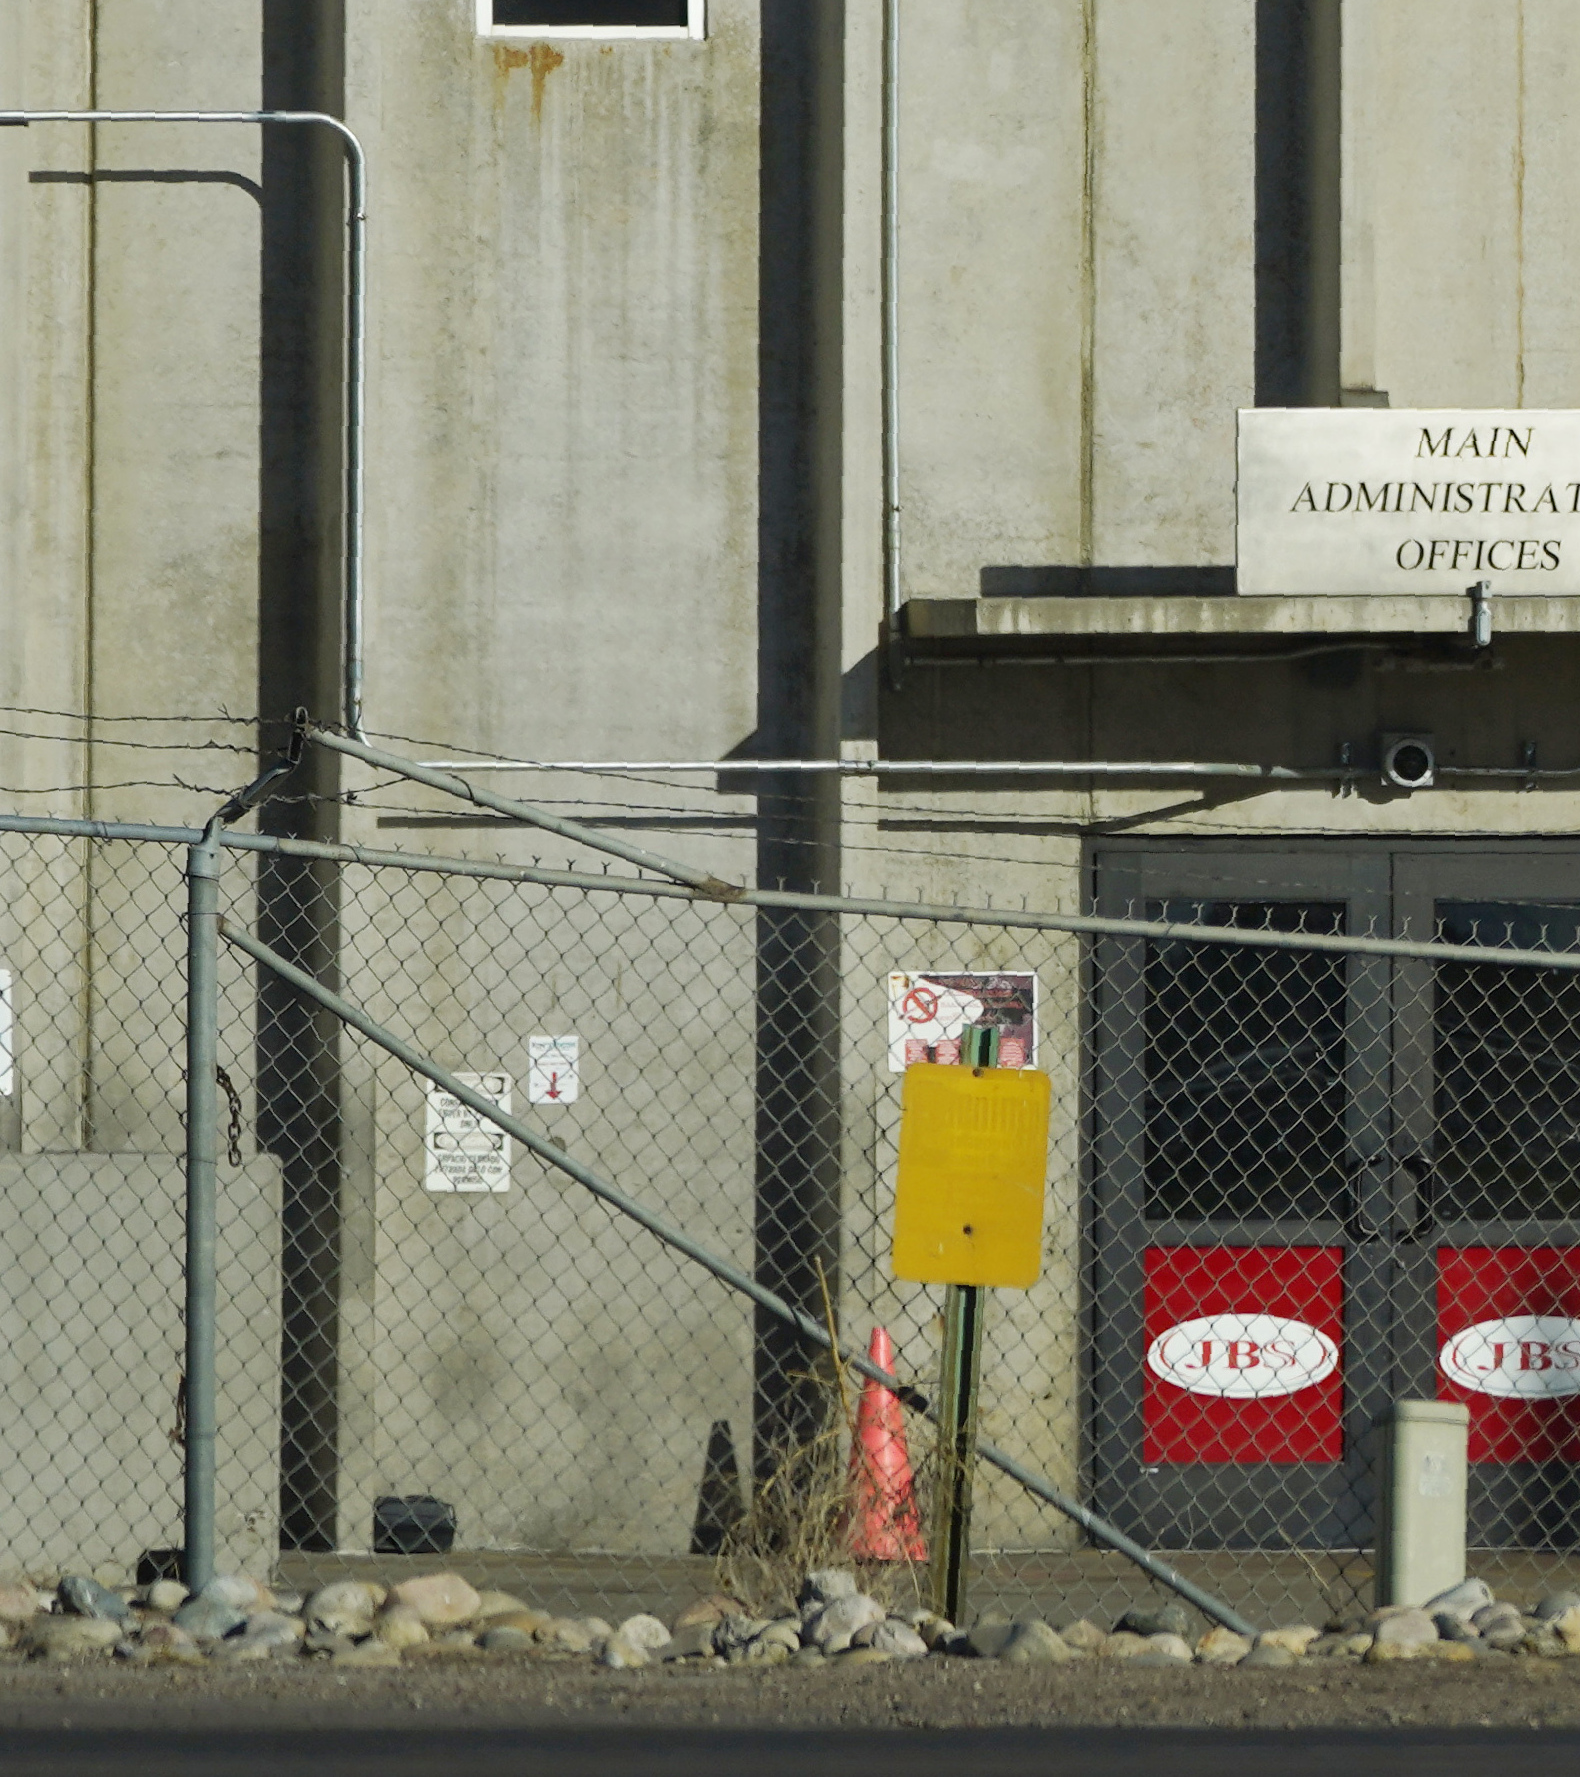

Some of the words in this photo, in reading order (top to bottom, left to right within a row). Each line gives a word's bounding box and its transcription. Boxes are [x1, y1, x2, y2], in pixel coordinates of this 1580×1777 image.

[1415, 426, 1536, 459] MAIN
[1395, 538, 1563, 572] OFFICES
[1185, 1339, 1297, 1370] JBS
